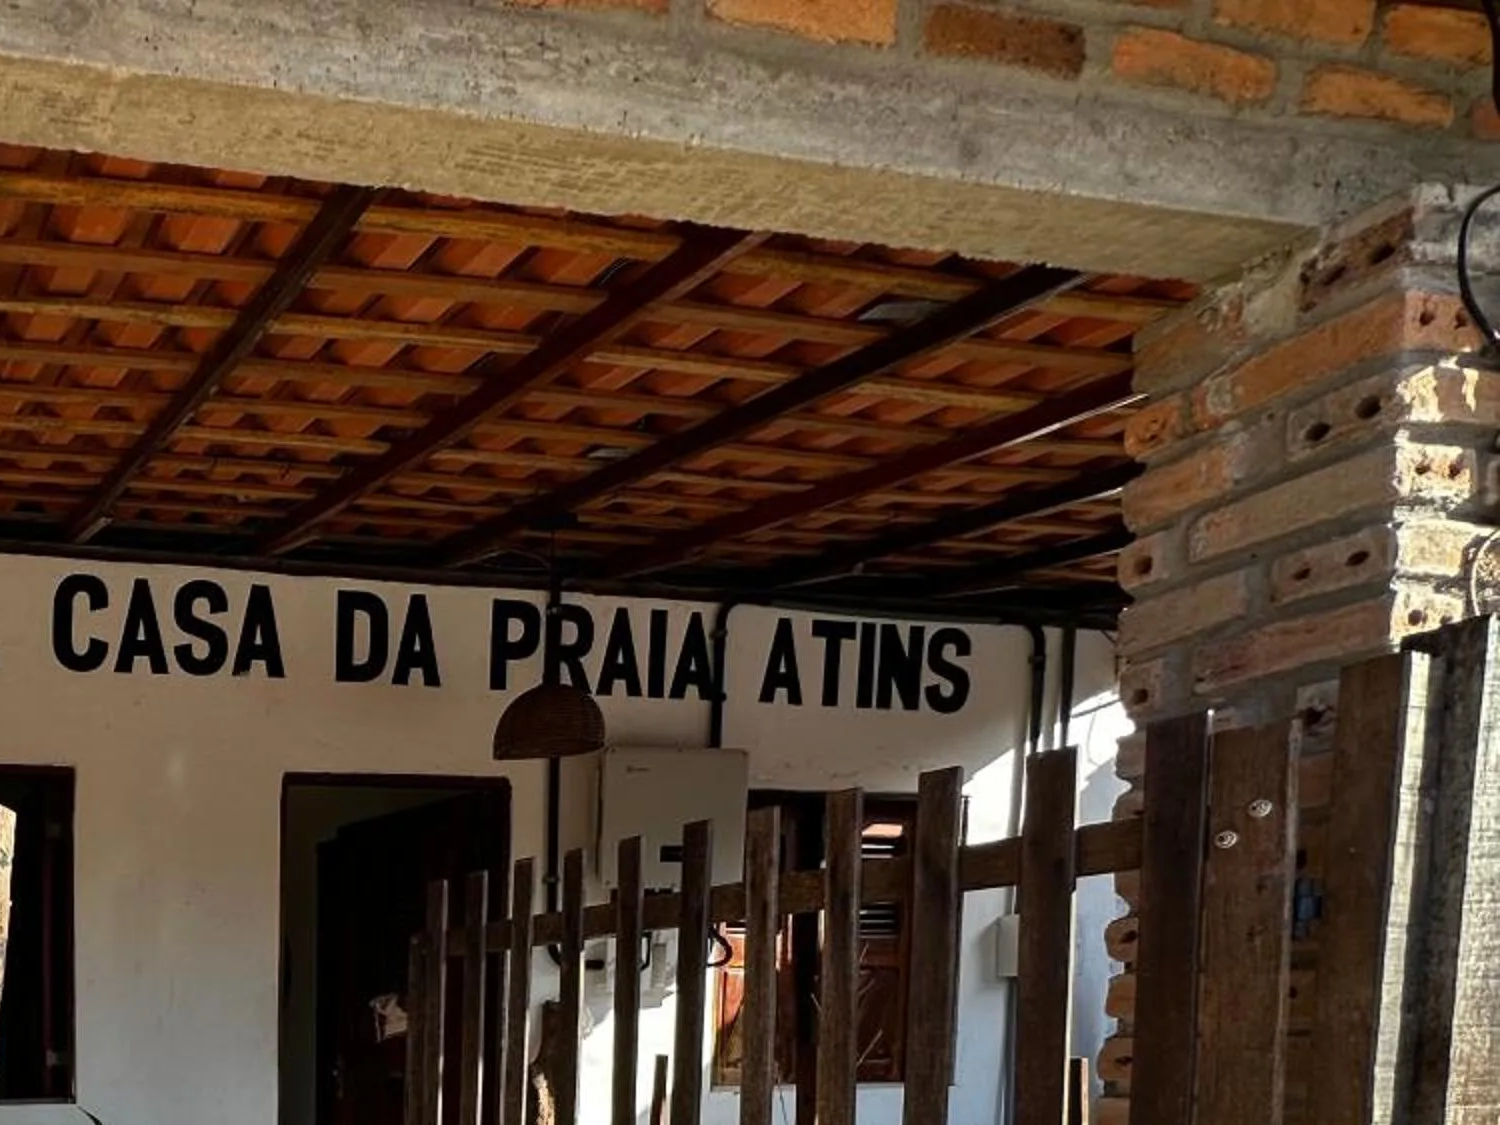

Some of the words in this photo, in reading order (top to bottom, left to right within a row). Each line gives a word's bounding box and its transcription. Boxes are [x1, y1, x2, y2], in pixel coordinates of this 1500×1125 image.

[52, 573, 285, 677] CASA
[335, 589, 440, 687] DA
[489, 598, 718, 701] PRAIA
[758, 617, 972, 713] ATINS
